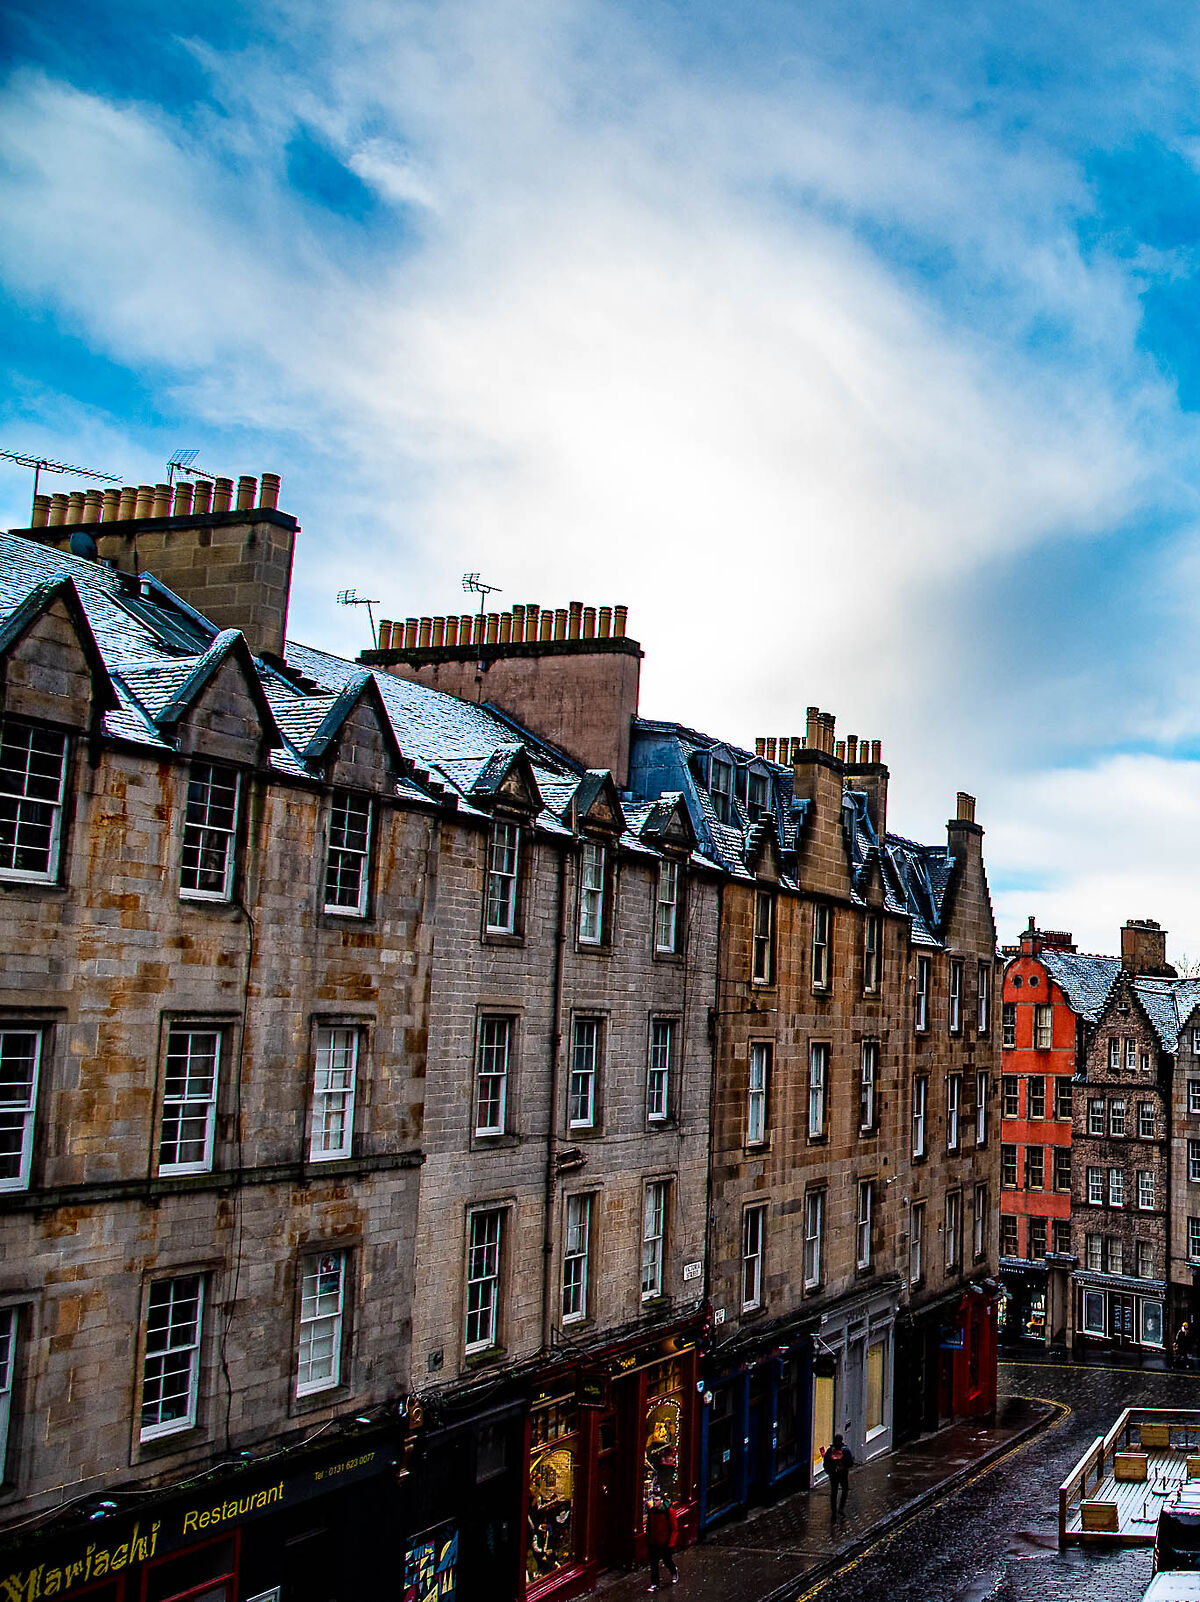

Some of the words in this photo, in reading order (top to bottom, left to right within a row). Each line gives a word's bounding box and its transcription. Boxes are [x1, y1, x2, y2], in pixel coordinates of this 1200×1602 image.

[315, 1470, 324, 1480] Tel
[328, 1462, 345, 1477] 0131
[345, 1458, 358, 1470] 623
[358, 1452, 376, 1465] 0077
[0, 1520, 161, 1602] Mariachi
[183, 1480, 285, 1535] Restaurant
